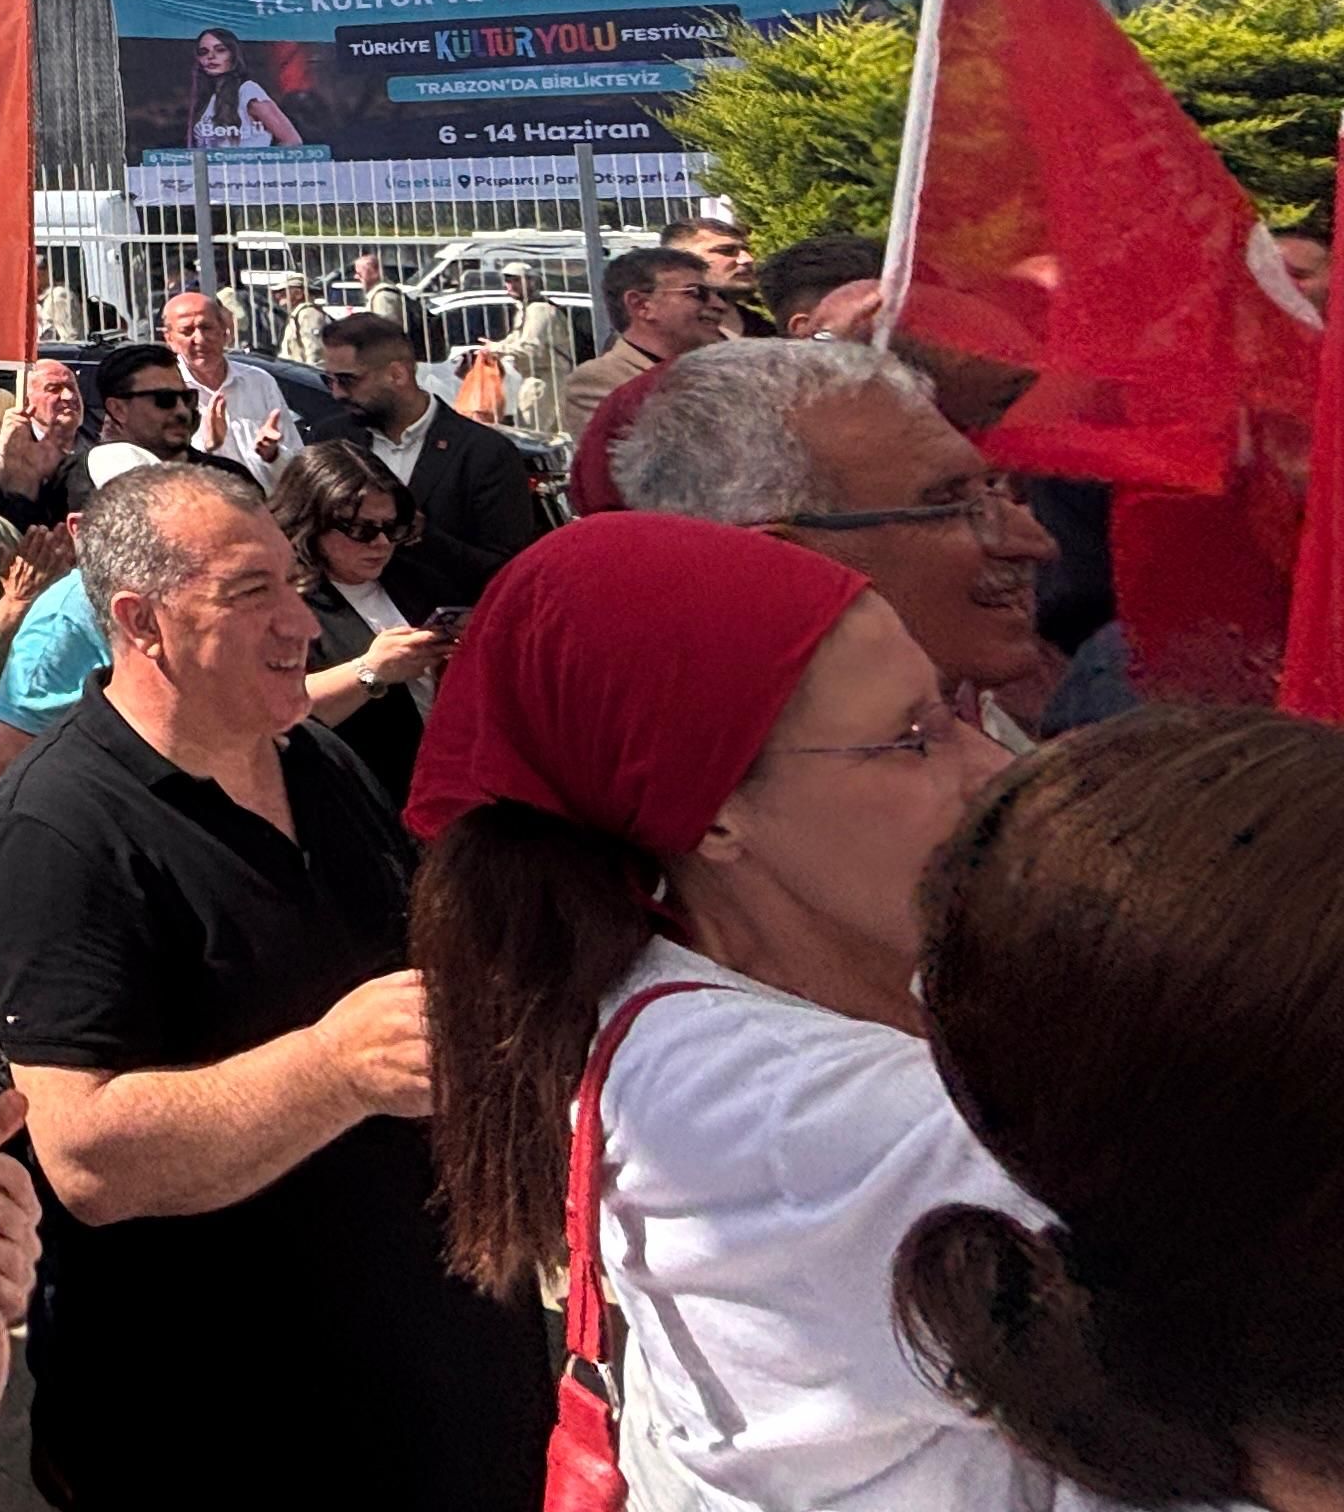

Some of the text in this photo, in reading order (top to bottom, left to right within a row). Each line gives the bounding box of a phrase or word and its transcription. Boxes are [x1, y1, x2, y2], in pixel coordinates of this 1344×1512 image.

[348, 38, 431, 56] TÜRKİYE
[416, 69, 661, 95] TRABZON'DA BİRLİKTEYİZ
[439, 125, 458, 144] 6
[483, 123, 517, 142] 14
[524, 118, 650, 142] Haziran
